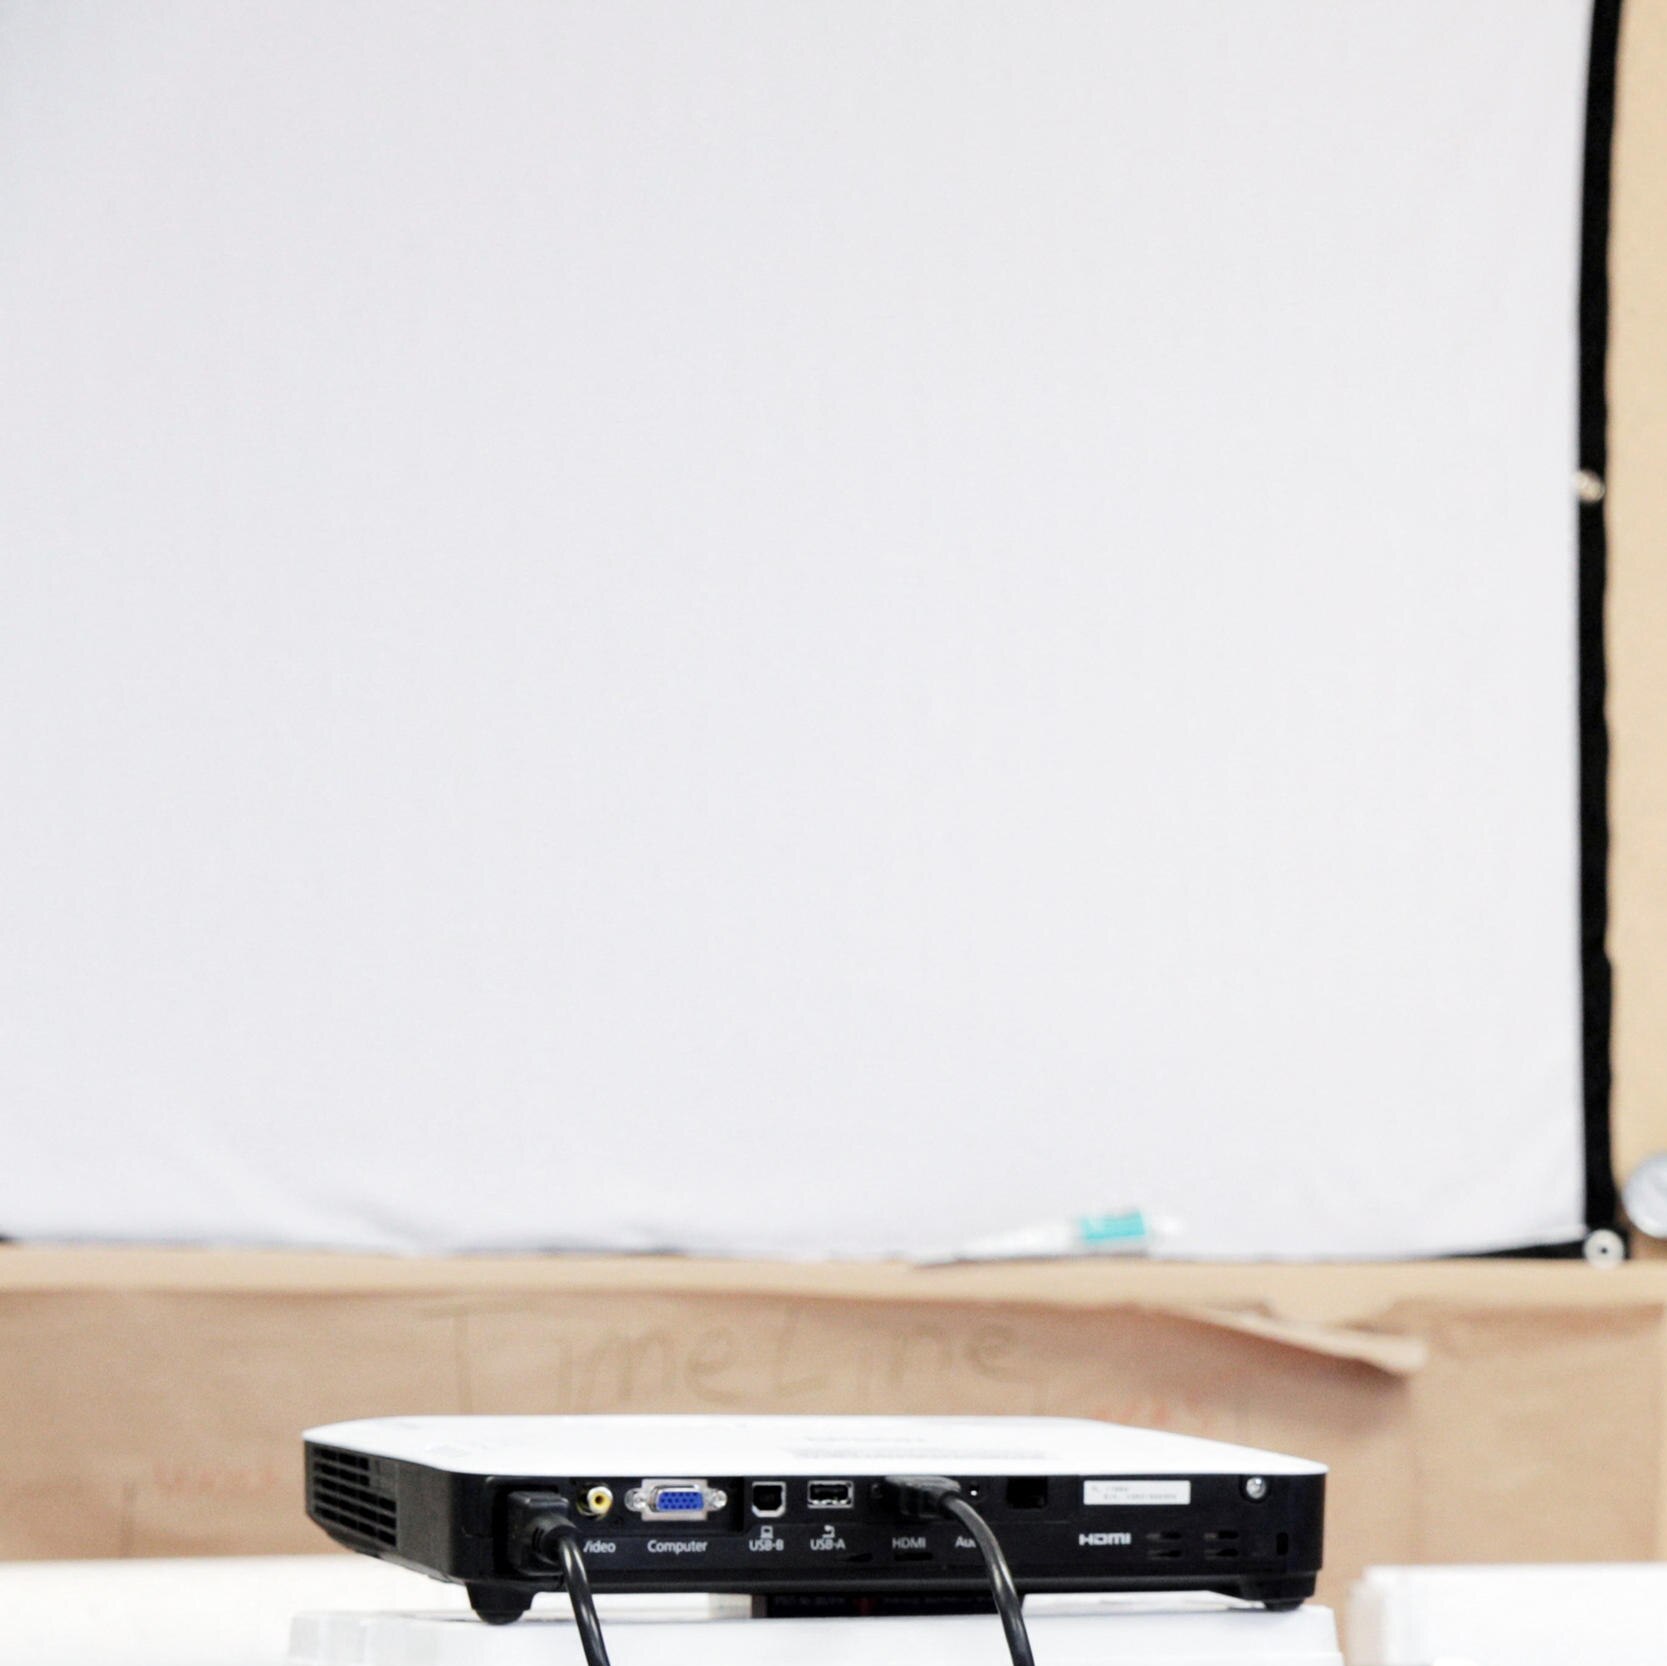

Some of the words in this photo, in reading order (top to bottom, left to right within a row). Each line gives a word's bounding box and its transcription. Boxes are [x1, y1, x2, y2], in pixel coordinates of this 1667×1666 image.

[749, 1538, 784, 1551] USB-B
[810, 1538, 845, 1551] USB-A
[892, 1537, 926, 1549] HDMI
[1079, 1533, 1132, 1546] HDMI
[646, 1539, 707, 1556] Computer
